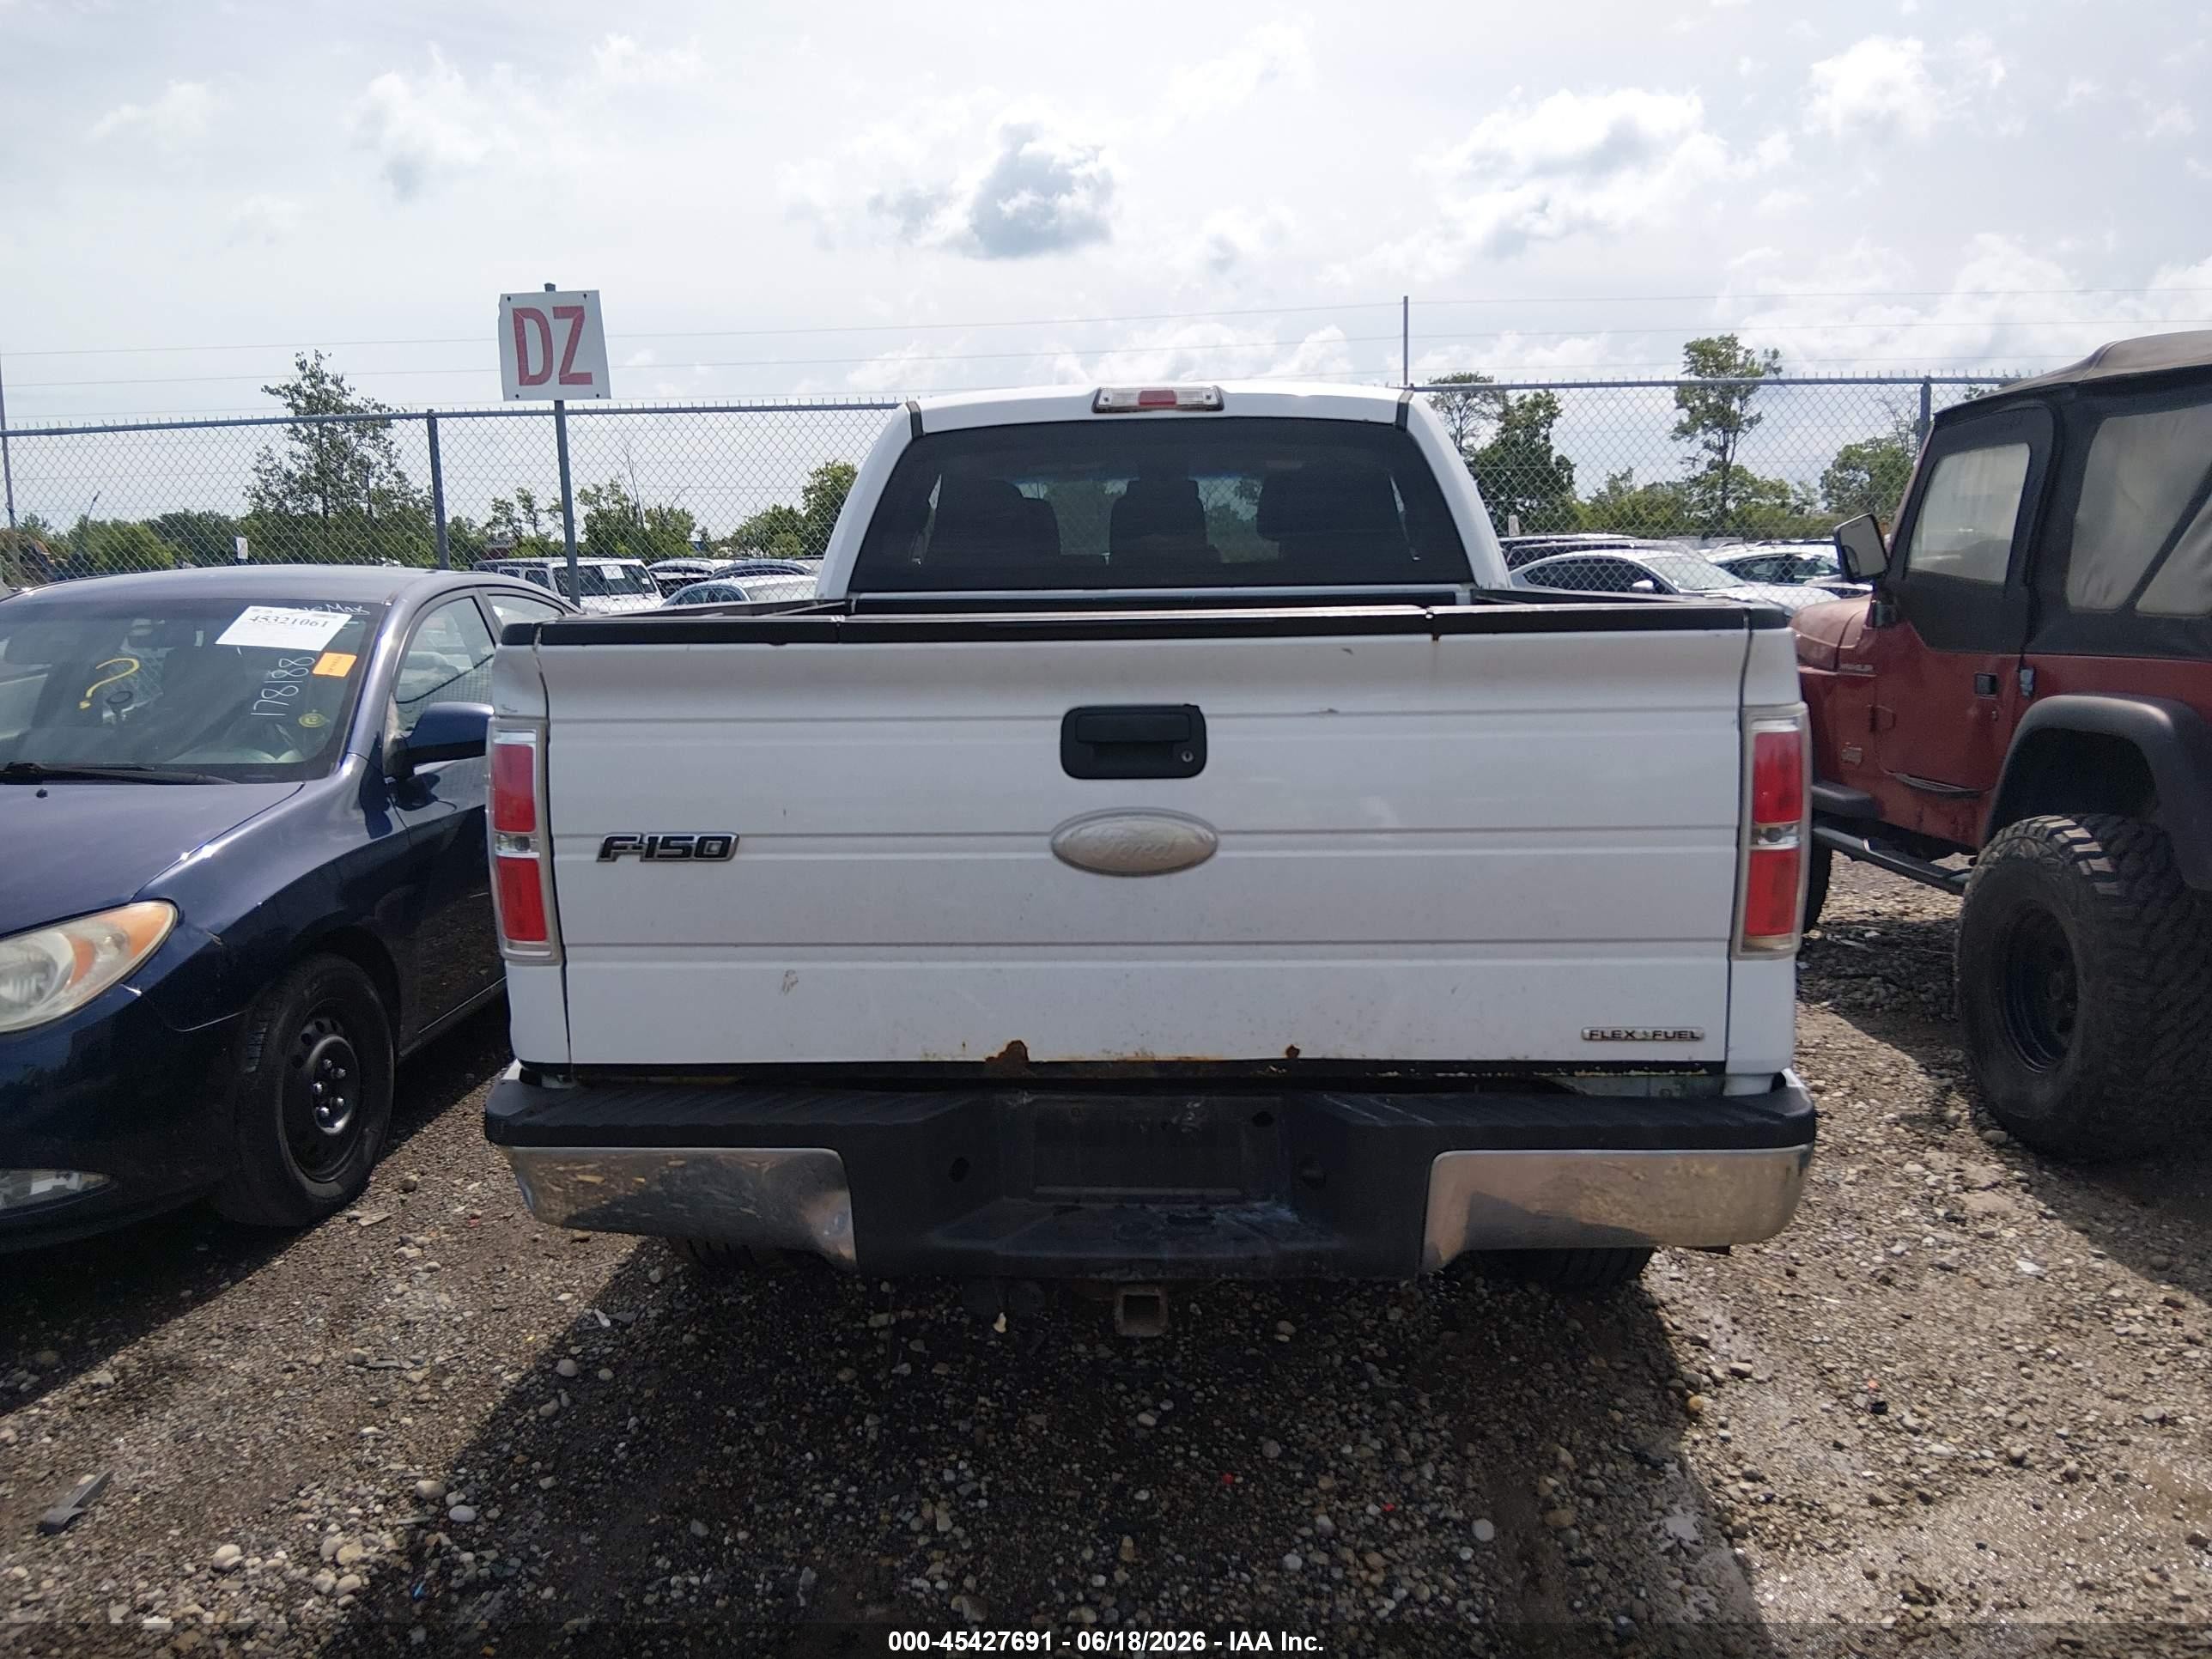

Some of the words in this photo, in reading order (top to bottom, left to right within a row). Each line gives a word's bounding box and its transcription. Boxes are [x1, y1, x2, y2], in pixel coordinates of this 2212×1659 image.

[512, 305, 593, 386] DZ
[250, 656, 316, 716] 178188
[596, 833, 740, 862] F-150
[1589, 1030, 1636, 1040] FLEX
[1651, 1030, 1700, 1040] FUEL
